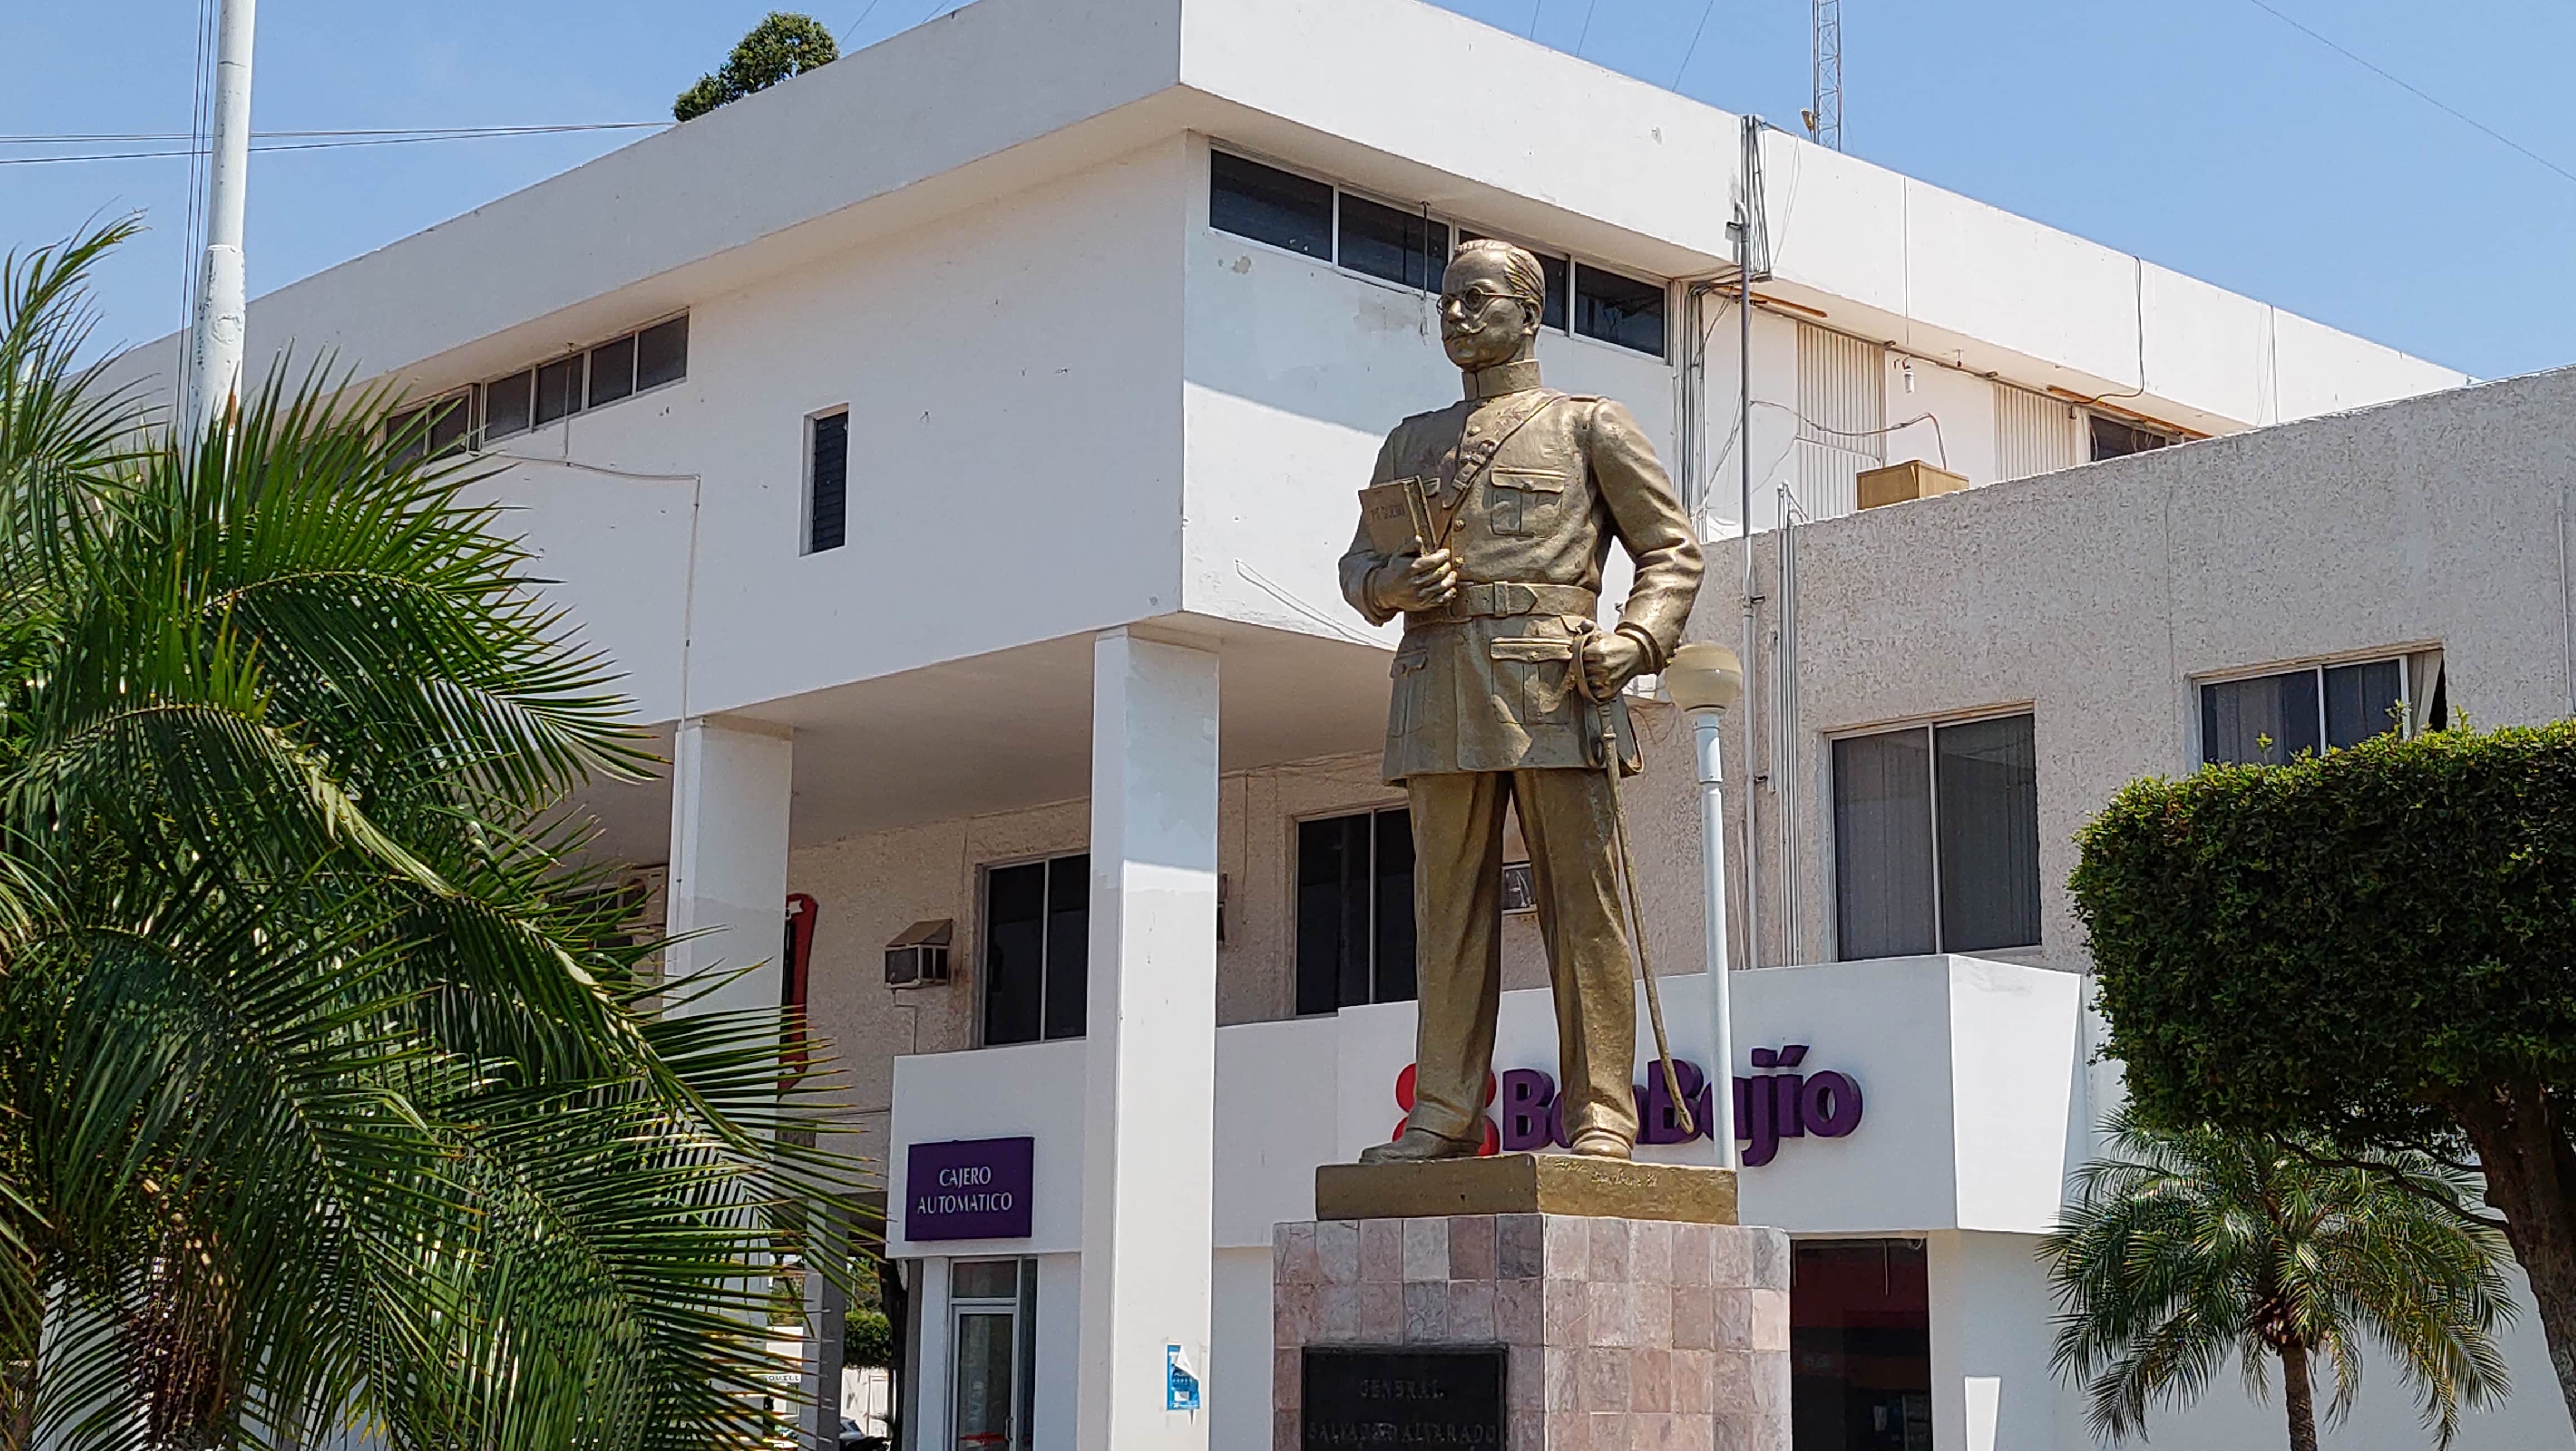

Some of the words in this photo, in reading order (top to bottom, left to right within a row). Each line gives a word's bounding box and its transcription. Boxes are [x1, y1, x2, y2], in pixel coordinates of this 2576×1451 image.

[939, 1166, 991, 1188] CAJERO
[917, 1192, 1013, 1214] AUTOMATICO
[1402, 1421, 1497, 1443] ALVARADO
